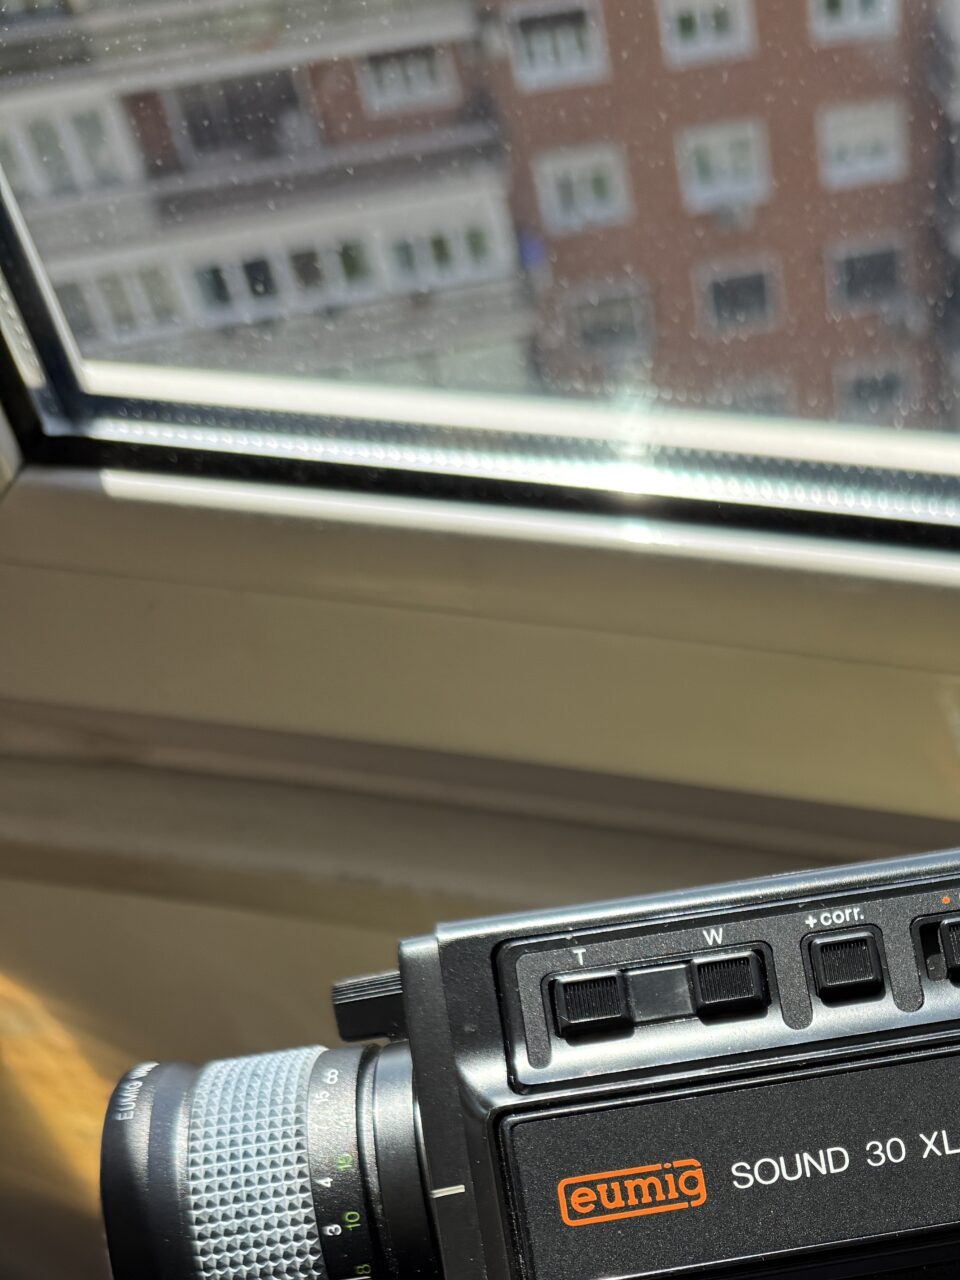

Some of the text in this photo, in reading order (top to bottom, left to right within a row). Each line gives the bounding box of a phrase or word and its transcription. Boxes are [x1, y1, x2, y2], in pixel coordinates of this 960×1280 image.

[702, 927, 724, 946] W
[571, 945, 587, 966] T
[114, 1079, 143, 1121] EUMIG
[316, 1176, 333, 1189] 4
[570, 1162, 705, 1214] eumig
[731, 1140, 850, 1189] SOUND
[865, 1137, 907, 1167] 30
[323, 1224, 343, 1237] 3
[344, 1210, 362, 1231] 10
[355, 1263, 372, 1275] 8
